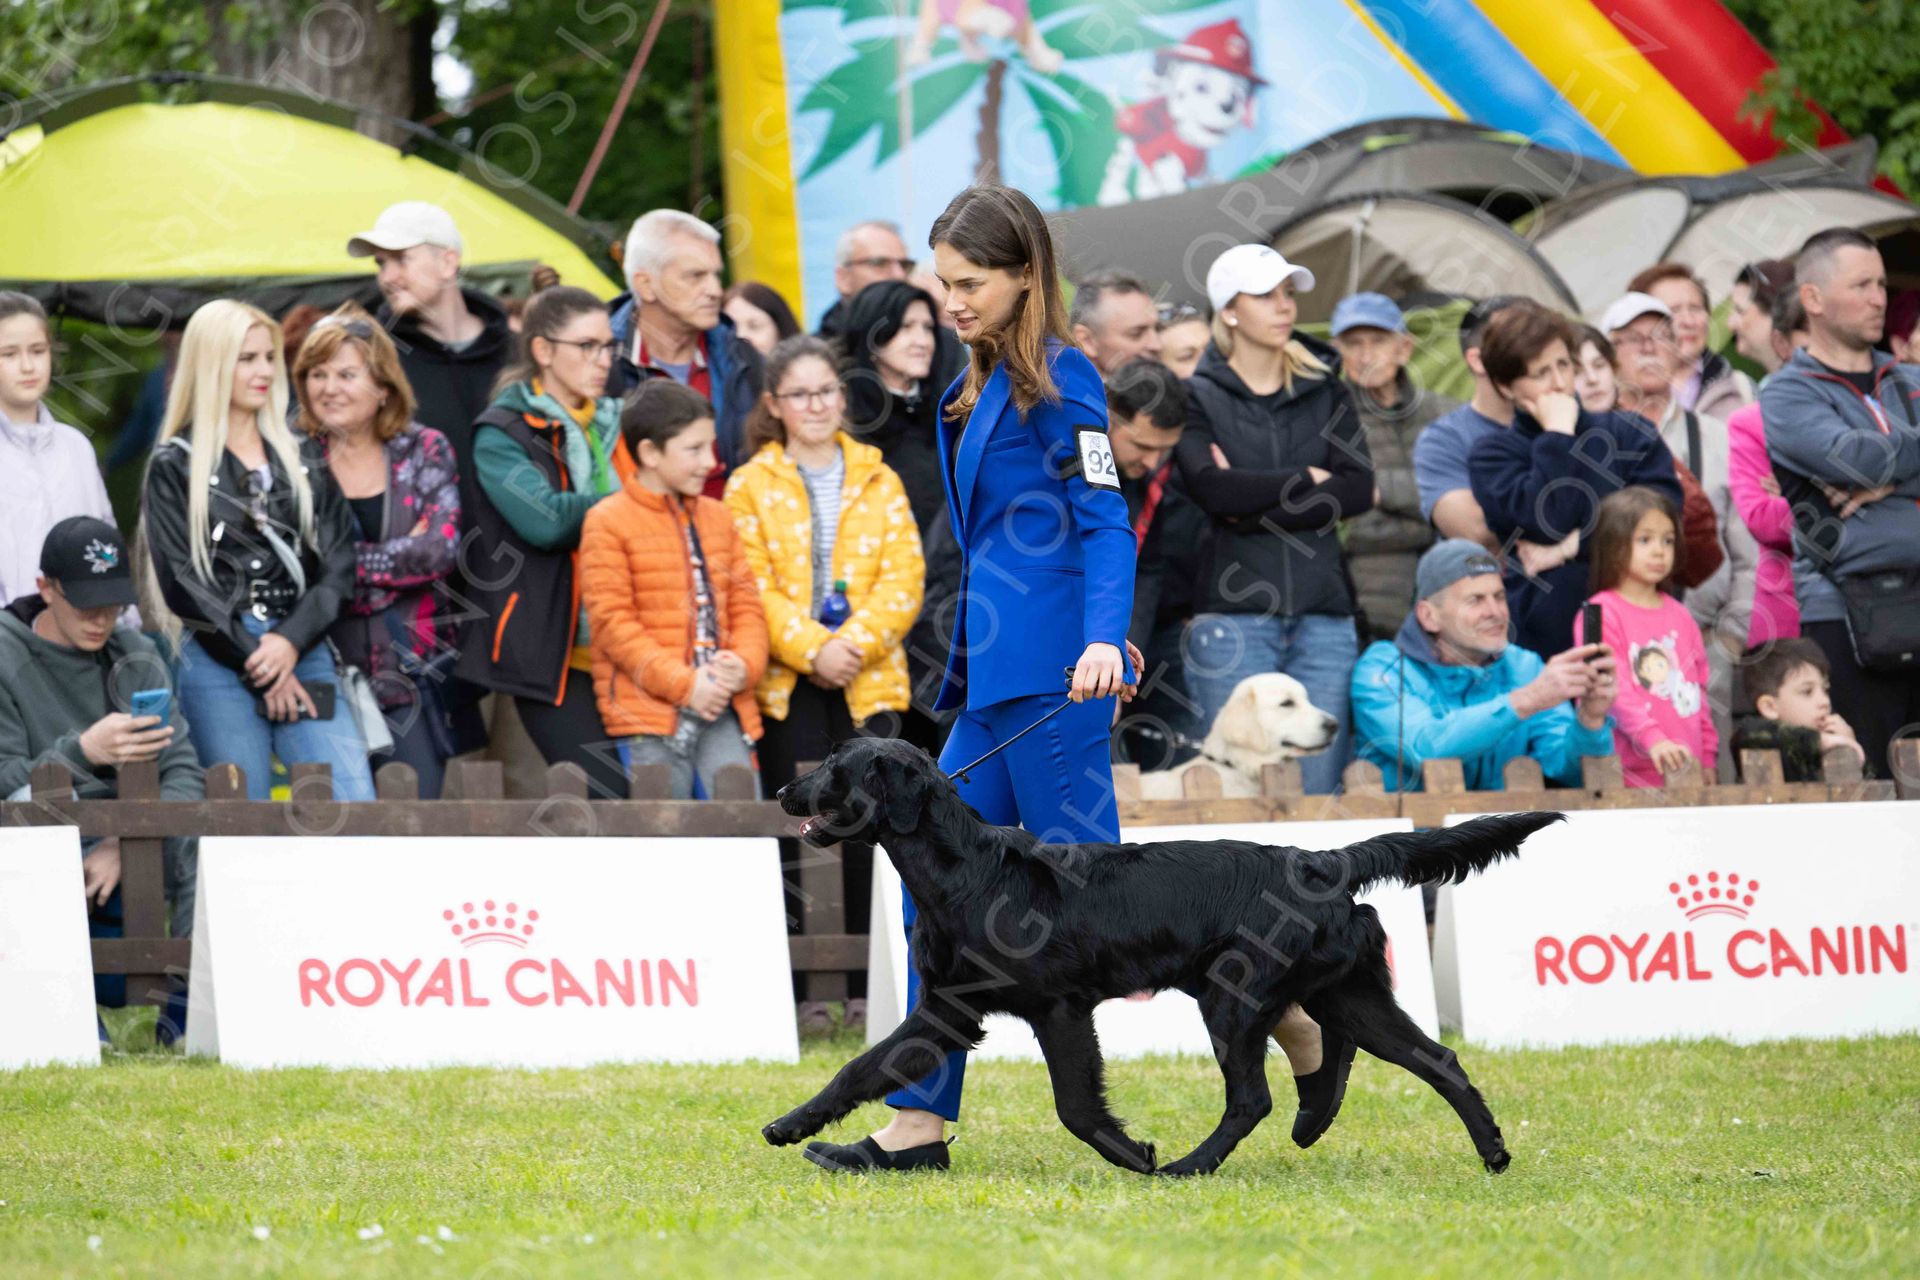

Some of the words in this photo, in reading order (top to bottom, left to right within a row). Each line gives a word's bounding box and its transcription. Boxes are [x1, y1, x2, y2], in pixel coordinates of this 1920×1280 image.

[1088, 450, 1115, 476] 92
[1534, 931, 1712, 986] ROYAL
[1726, 924, 1908, 979] CANIN
[298, 957, 490, 1007] ROYAL
[505, 957, 699, 1007] CANIN
